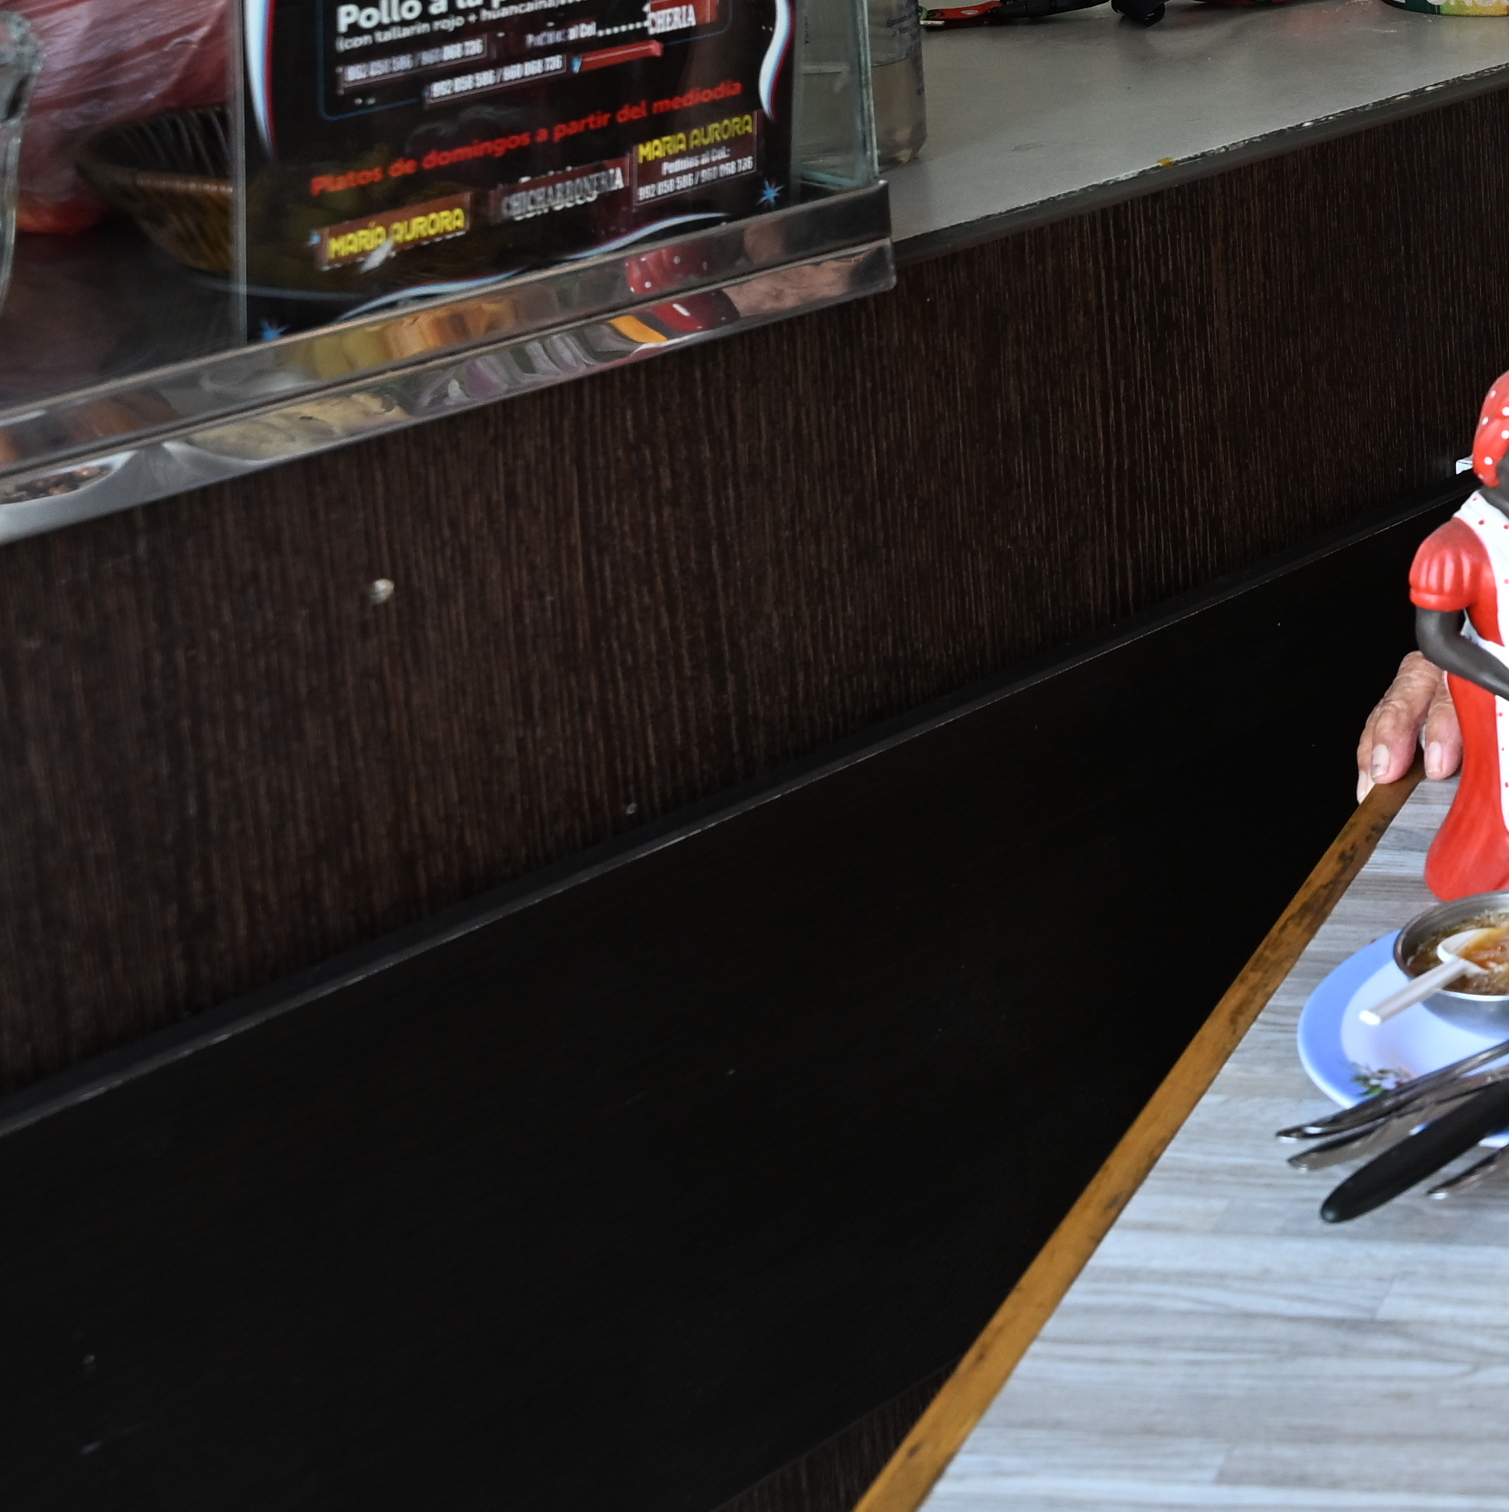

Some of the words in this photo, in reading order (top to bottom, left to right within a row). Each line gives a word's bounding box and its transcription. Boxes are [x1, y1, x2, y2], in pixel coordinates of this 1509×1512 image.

[310, 167, 383, 196] Platos
[388, 158, 417, 177] de
[422, 132, 531, 169] domingos
[537, 128, 549, 142] a
[554, 111, 612, 142] partir
[616, 101, 647, 124] del
[689, 114, 753, 149] AURORA
[390, 208, 465, 244] AURORA
